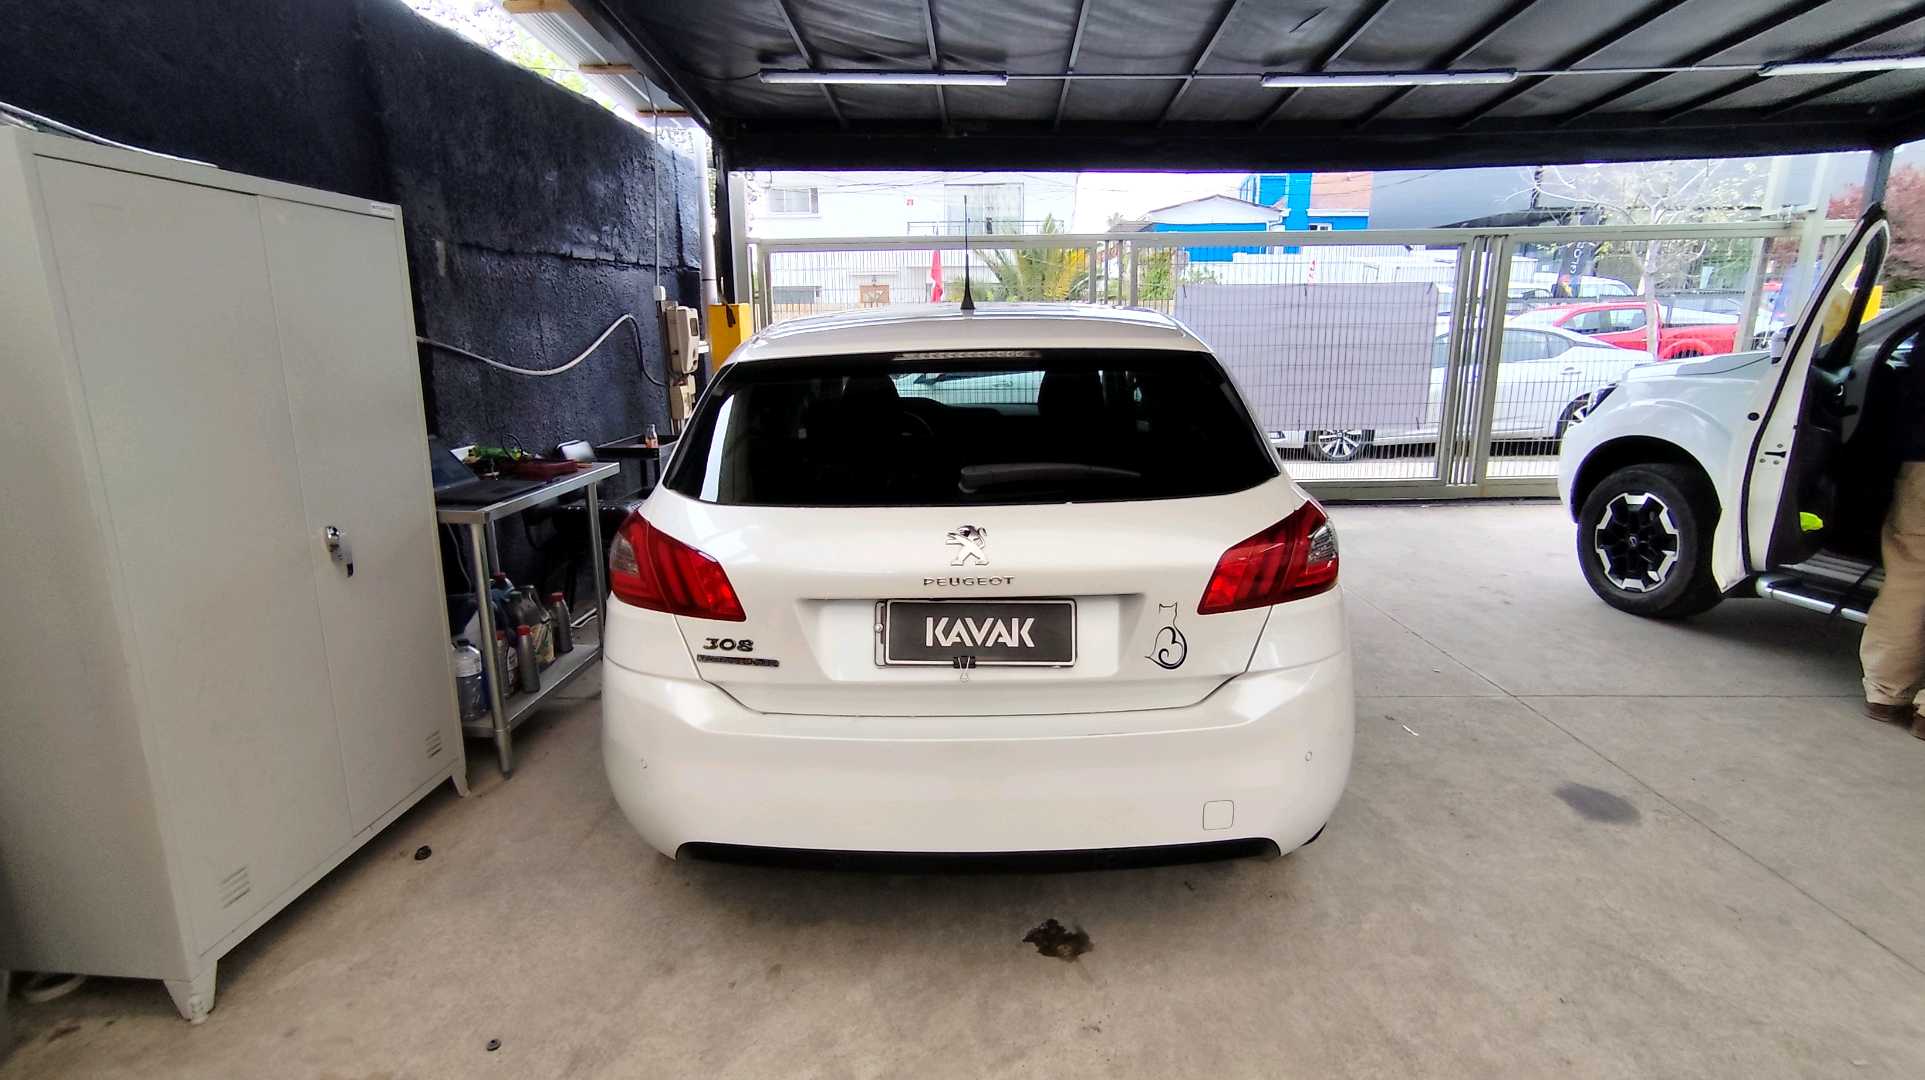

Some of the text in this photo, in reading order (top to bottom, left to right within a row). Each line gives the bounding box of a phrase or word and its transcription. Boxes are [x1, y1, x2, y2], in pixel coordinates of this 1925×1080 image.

[923, 576, 1015, 587] PEUGEOT
[925, 616, 1036, 648] KAVAK
[703, 637, 754, 652] 308
